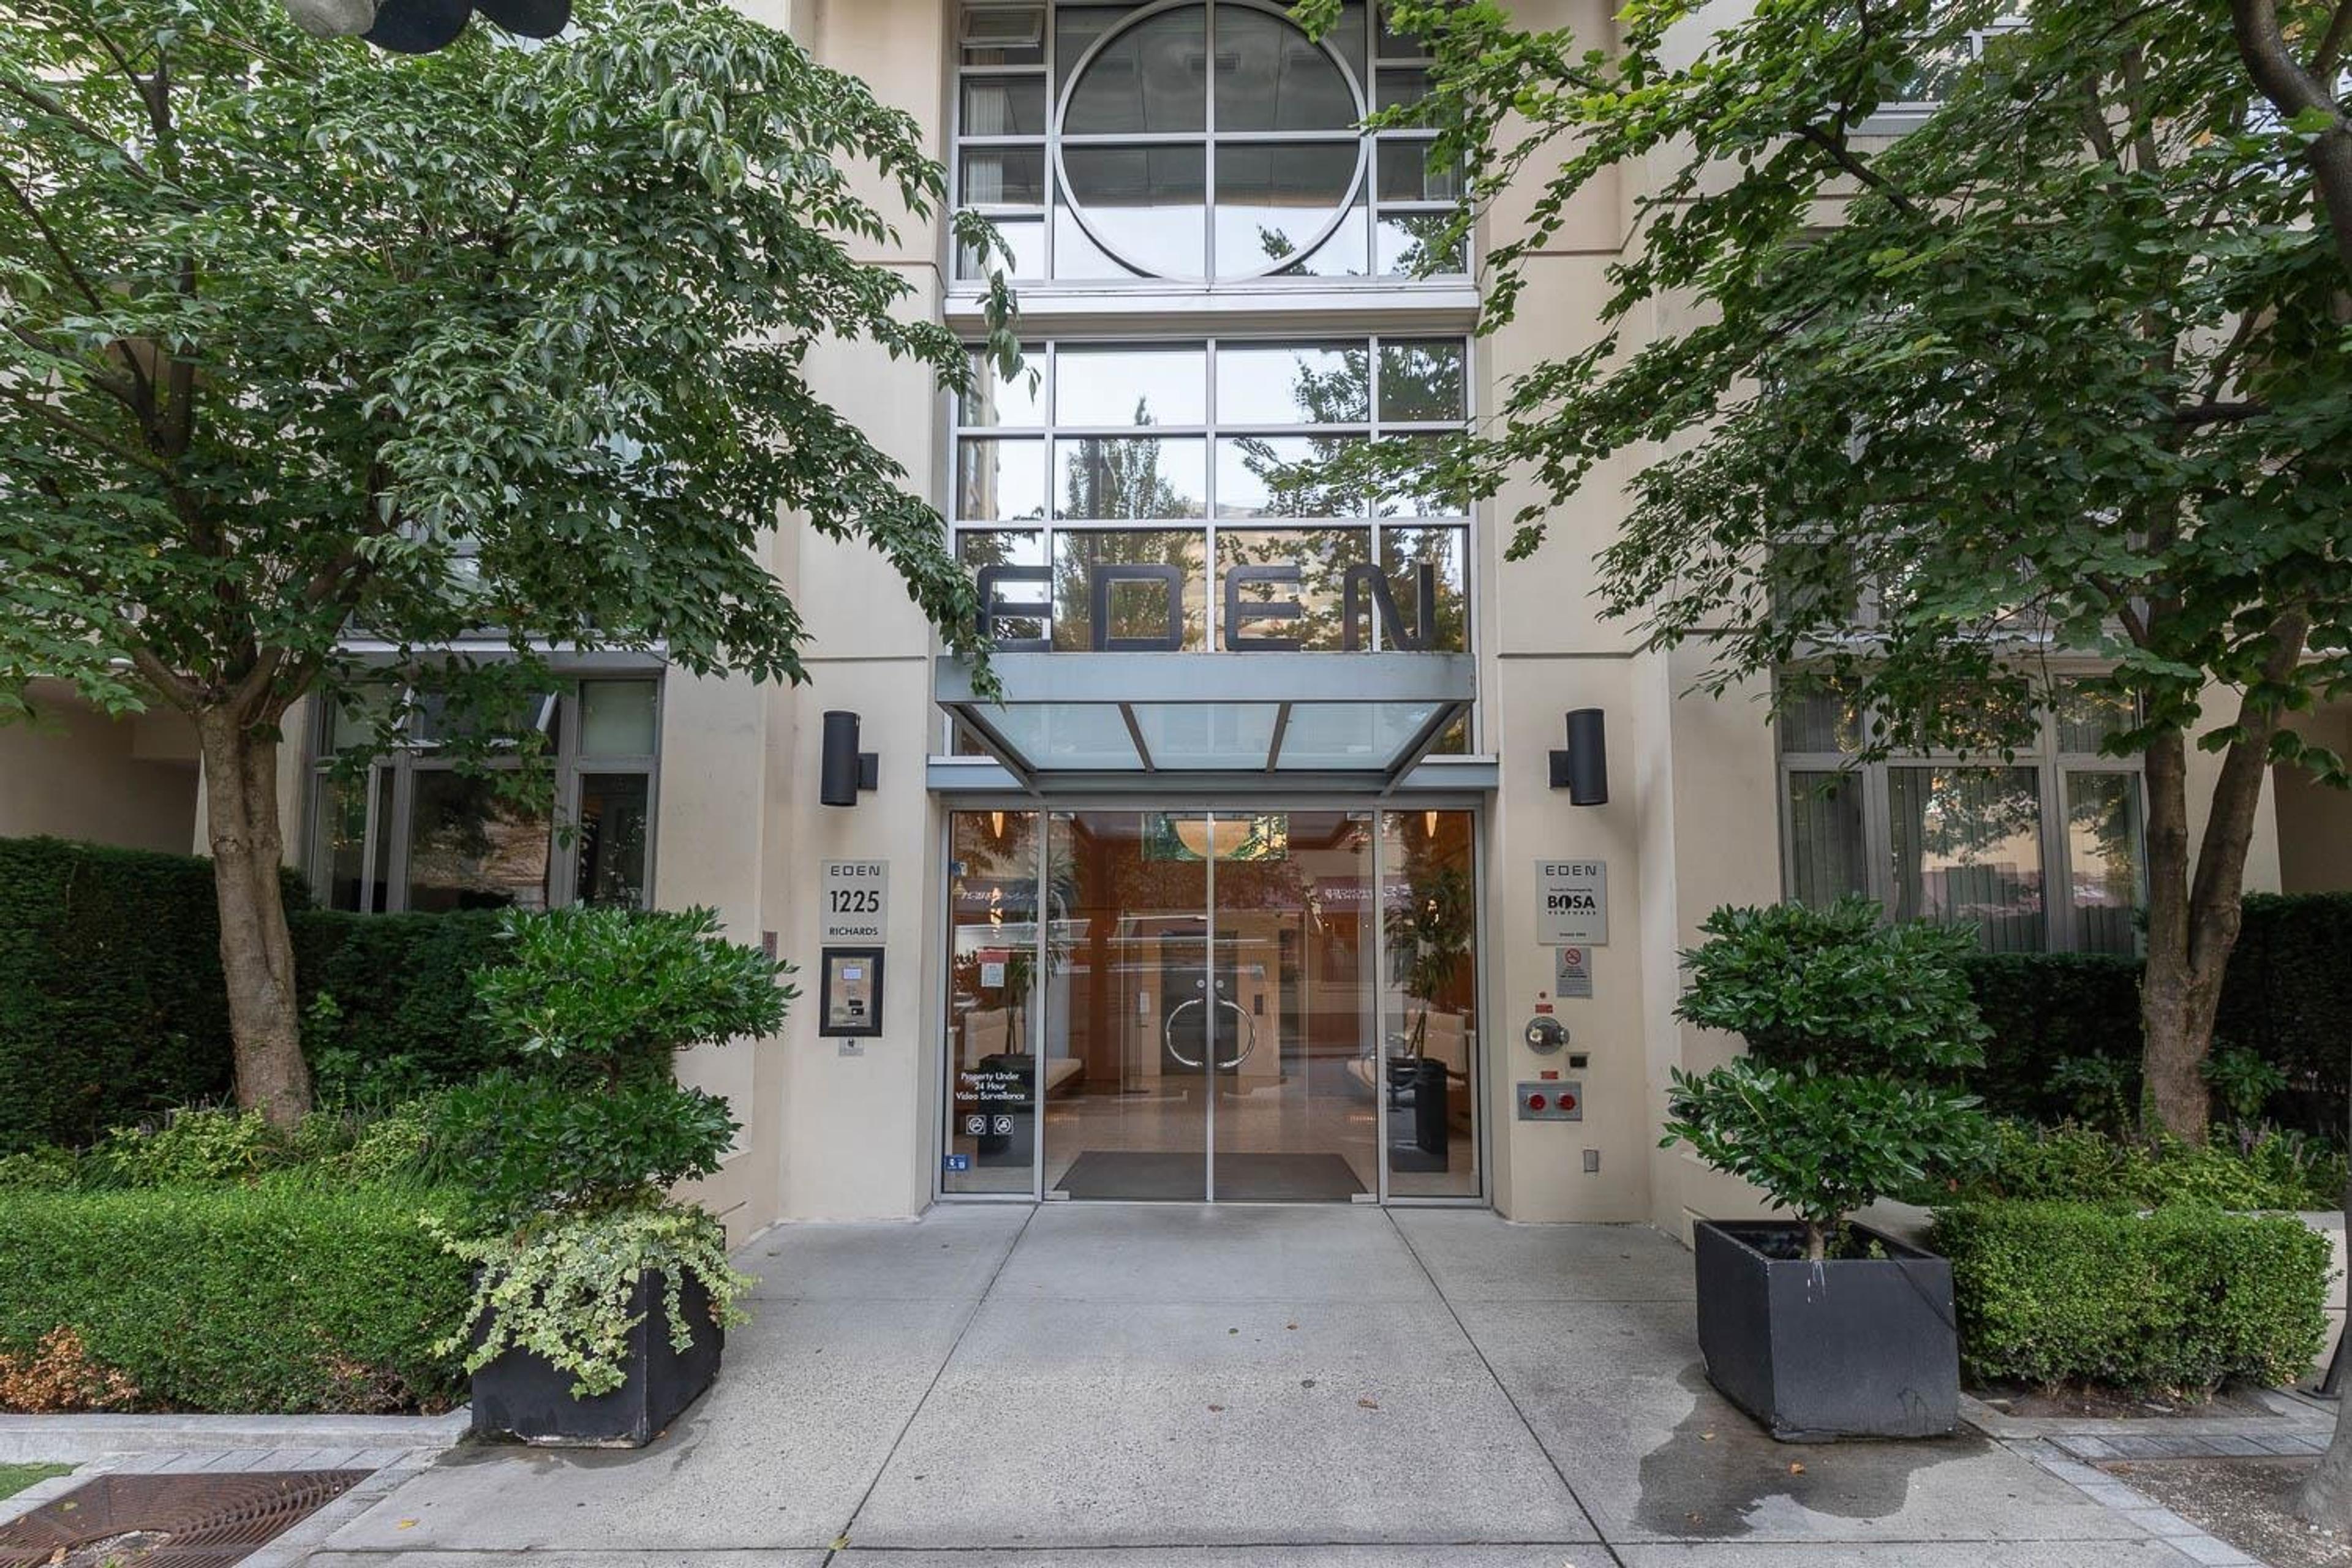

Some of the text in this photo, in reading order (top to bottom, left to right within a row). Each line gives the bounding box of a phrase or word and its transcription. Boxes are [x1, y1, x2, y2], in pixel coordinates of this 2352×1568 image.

[976, 564, 1435, 652] EDEN
[831, 865, 880, 876] EDEN
[1546, 865, 1596, 876] EDEN
[830, 891, 880, 913] 1225
[1548, 894, 1596, 910] BOSA
[829, 927, 878, 936] RICHARDS
[960, 1072, 993, 1082] Property
